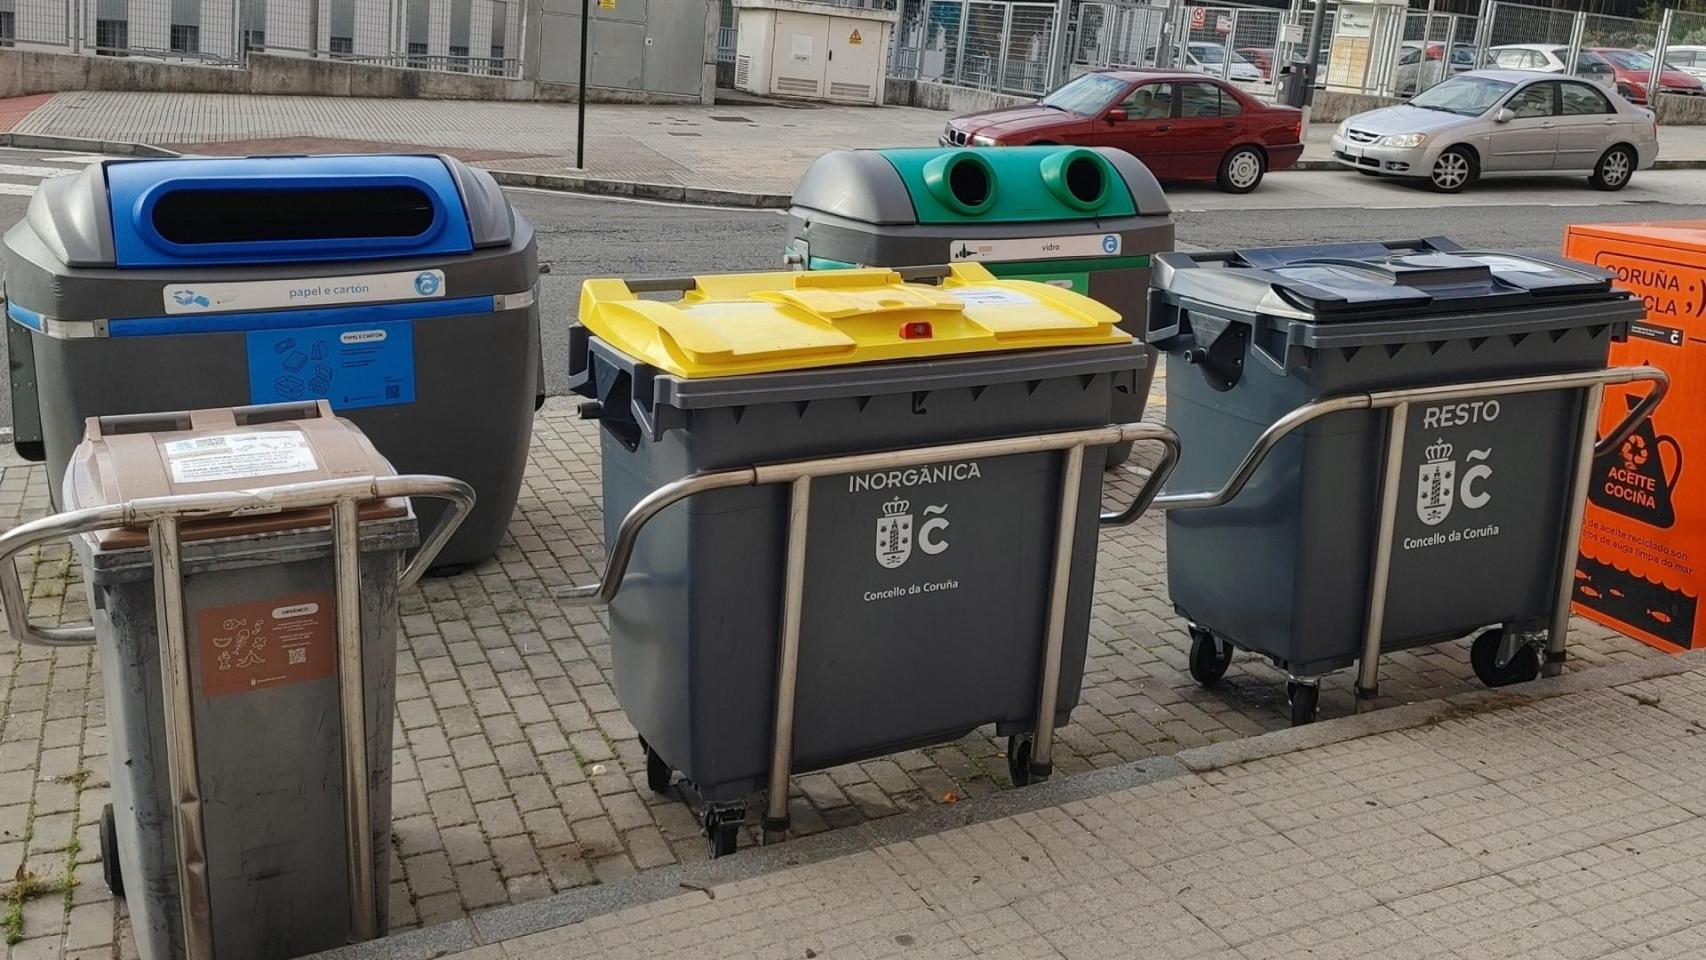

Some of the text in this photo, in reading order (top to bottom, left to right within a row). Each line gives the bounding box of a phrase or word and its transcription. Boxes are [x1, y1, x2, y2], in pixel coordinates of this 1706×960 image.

[1041, 243, 1061, 252] vidro
[289, 285, 321, 300] papel
[333, 283, 369, 295] cartón
[1423, 399, 1501, 430] RESTO
[1608, 466, 1656, 491] ACEITE
[1605, 482, 1656, 509] COCIÑA
[1403, 524, 1500, 551] Concello da Coruña
[1587, 519, 1600, 529] de
[1600, 523, 1627, 539] aceite
[1627, 533, 1669, 555] reciclado
[1670, 549, 1688, 561] son
[1600, 535, 1611, 546] de
[1612, 540, 1633, 554] auga
[1635, 546, 1659, 562] limpa
[1661, 557, 1673, 568] do
[1674, 562, 1694, 576] mar
[863, 579, 959, 601] Concello da Coruña
